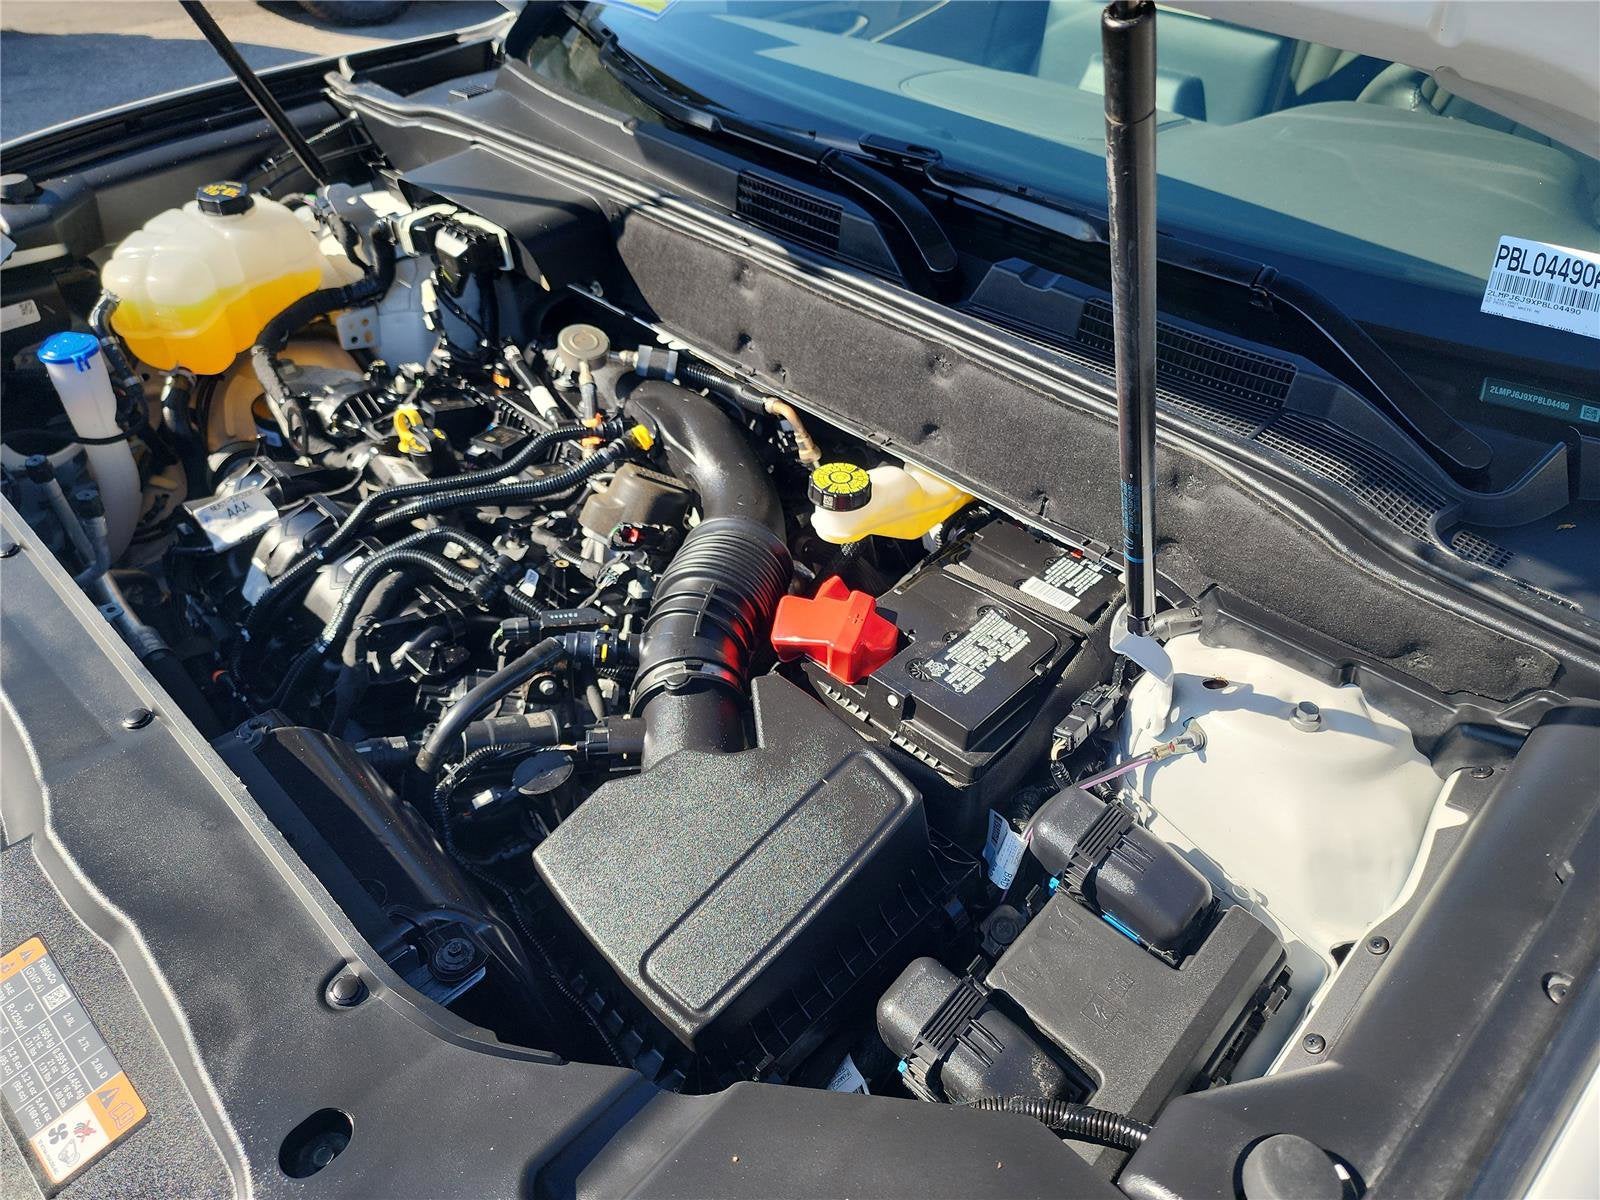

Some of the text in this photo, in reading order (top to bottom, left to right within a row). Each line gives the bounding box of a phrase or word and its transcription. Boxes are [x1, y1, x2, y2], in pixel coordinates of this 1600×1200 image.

[1488, 290, 1582, 315] 2LMPJ6J9XPBL04490
[227, 501, 250, 518] AAA
[38, 958, 56, 984] FoMoCo
